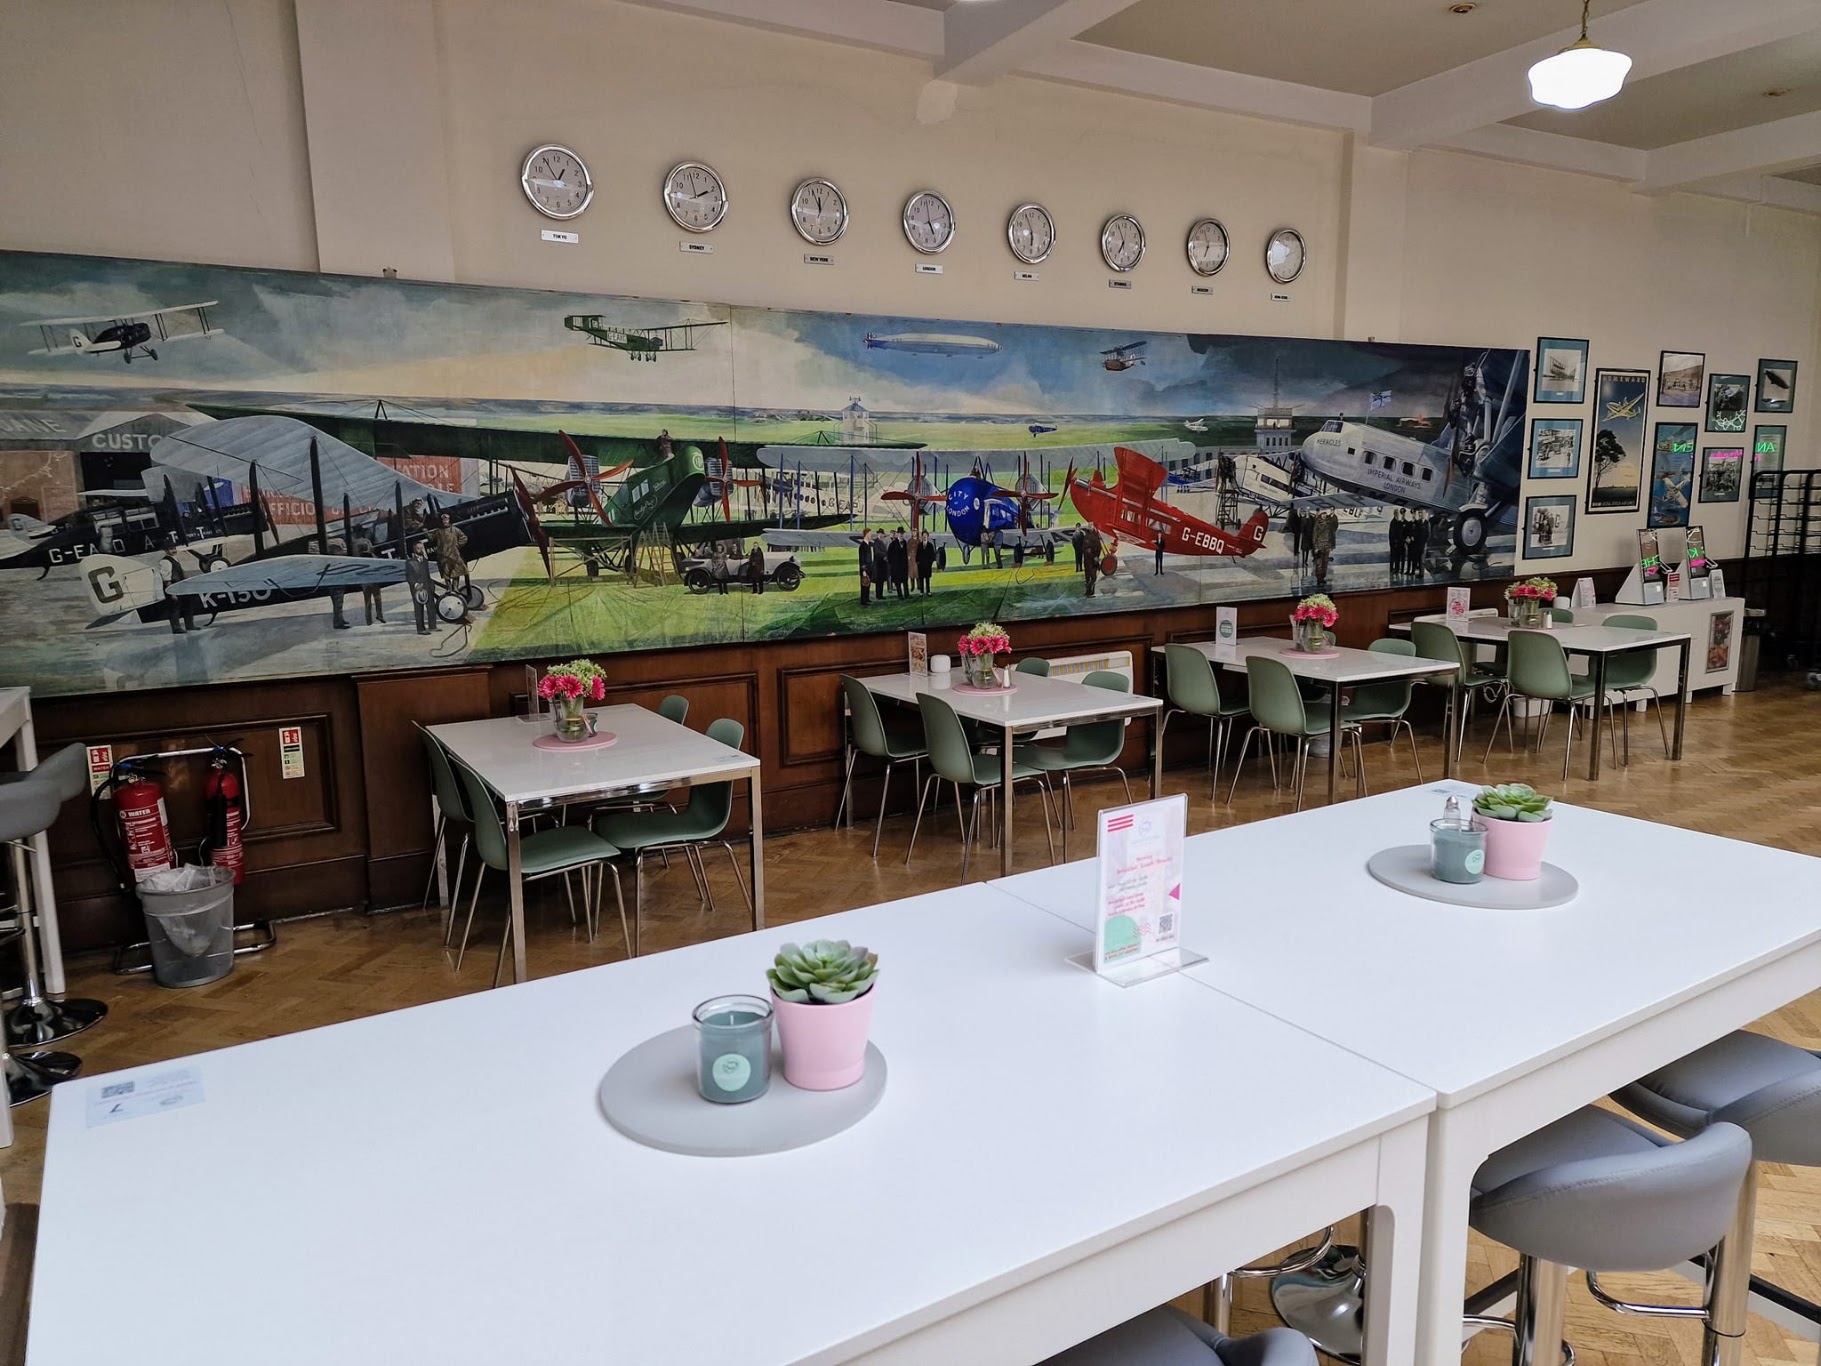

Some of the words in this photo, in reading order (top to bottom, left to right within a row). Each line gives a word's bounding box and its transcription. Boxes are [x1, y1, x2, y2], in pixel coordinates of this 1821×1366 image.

[72, 336, 82, 348] G
[1367, 468, 1393, 482] IMPERIAL
[1396, 476, 1422, 490] AIRWAYS
[948, 491, 969, 500] CITY
[946, 505, 970, 517] LONDON
[1254, 526, 1264, 541] G
[1182, 527, 1224, 554] G-EBBQ
[88, 566, 124, 604] G
[128, 808, 150, 817] WATER
